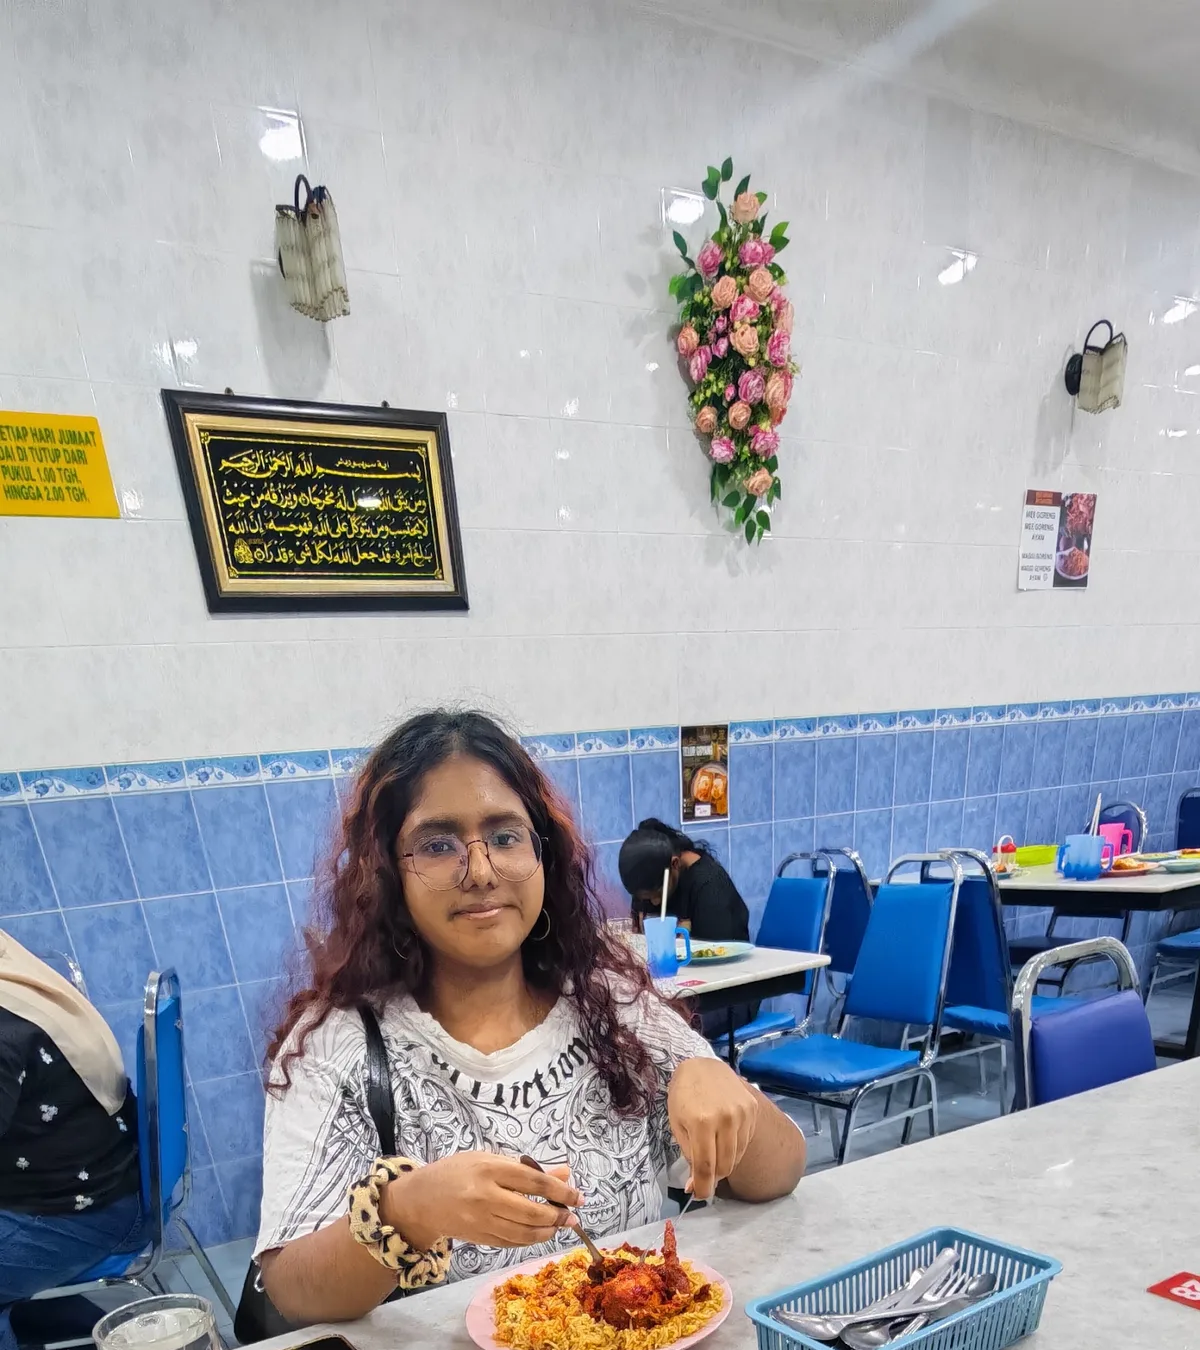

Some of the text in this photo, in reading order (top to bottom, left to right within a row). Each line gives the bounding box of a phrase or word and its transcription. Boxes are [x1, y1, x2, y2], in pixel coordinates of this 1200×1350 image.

[30, 427, 56, 444] HARI
[58, 429, 97, 447] JUMAAT
[16, 446, 28, 461] DI
[28, 447, 61, 463] TUTUP
[62, 449, 88, 465] DARI
[1, 465, 36, 482] PUKUL
[37, 467, 57, 483] 1.00
[3, 484, 43, 501] HINGGA
[44, 486, 65, 502] 2.00
[430, 1037, 592, 1111] liction
